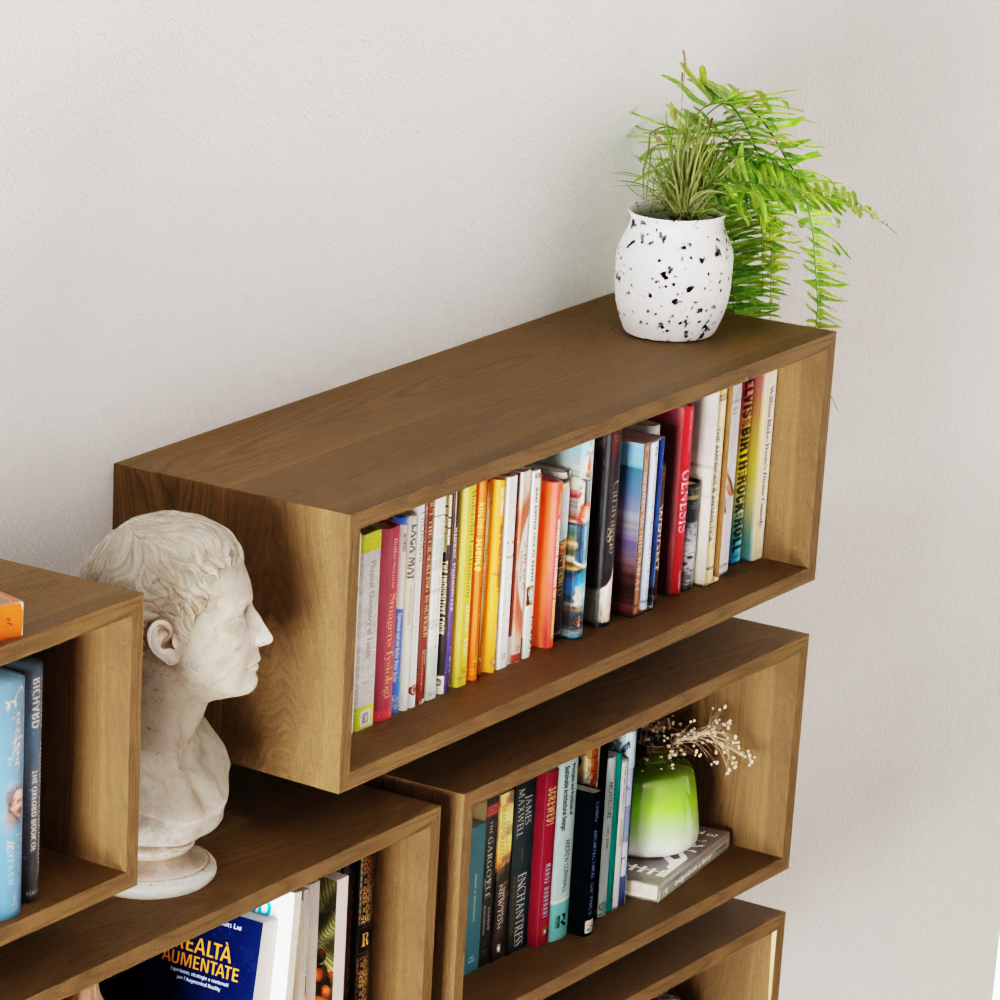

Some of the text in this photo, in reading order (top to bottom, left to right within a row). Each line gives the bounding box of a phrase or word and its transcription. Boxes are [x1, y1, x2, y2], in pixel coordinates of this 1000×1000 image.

[732, 380, 754, 553] ELVIS BIRTH ROCK ROLL
[607, 480, 620, 555] Caravaggio
[677, 469, 690, 534] GENESIS
[758, 498, 766, 528] Comedy
[474, 502, 486, 572] kitchen science
[368, 560, 377, 590] Physical
[386, 593, 397, 648] Smagens
[382, 651, 395, 700] fysiologi
[516, 788, 526, 840] MAXWELL
[524, 794, 533, 826] JAMES
[546, 786, 556, 827] SCREWED!
[484, 836, 494, 900] GARGOYLE
[513, 872, 527, 947] ENCHANTRESS
[161, 949, 240, 983] AUMENTATE
[361, 932, 369, 948] R
